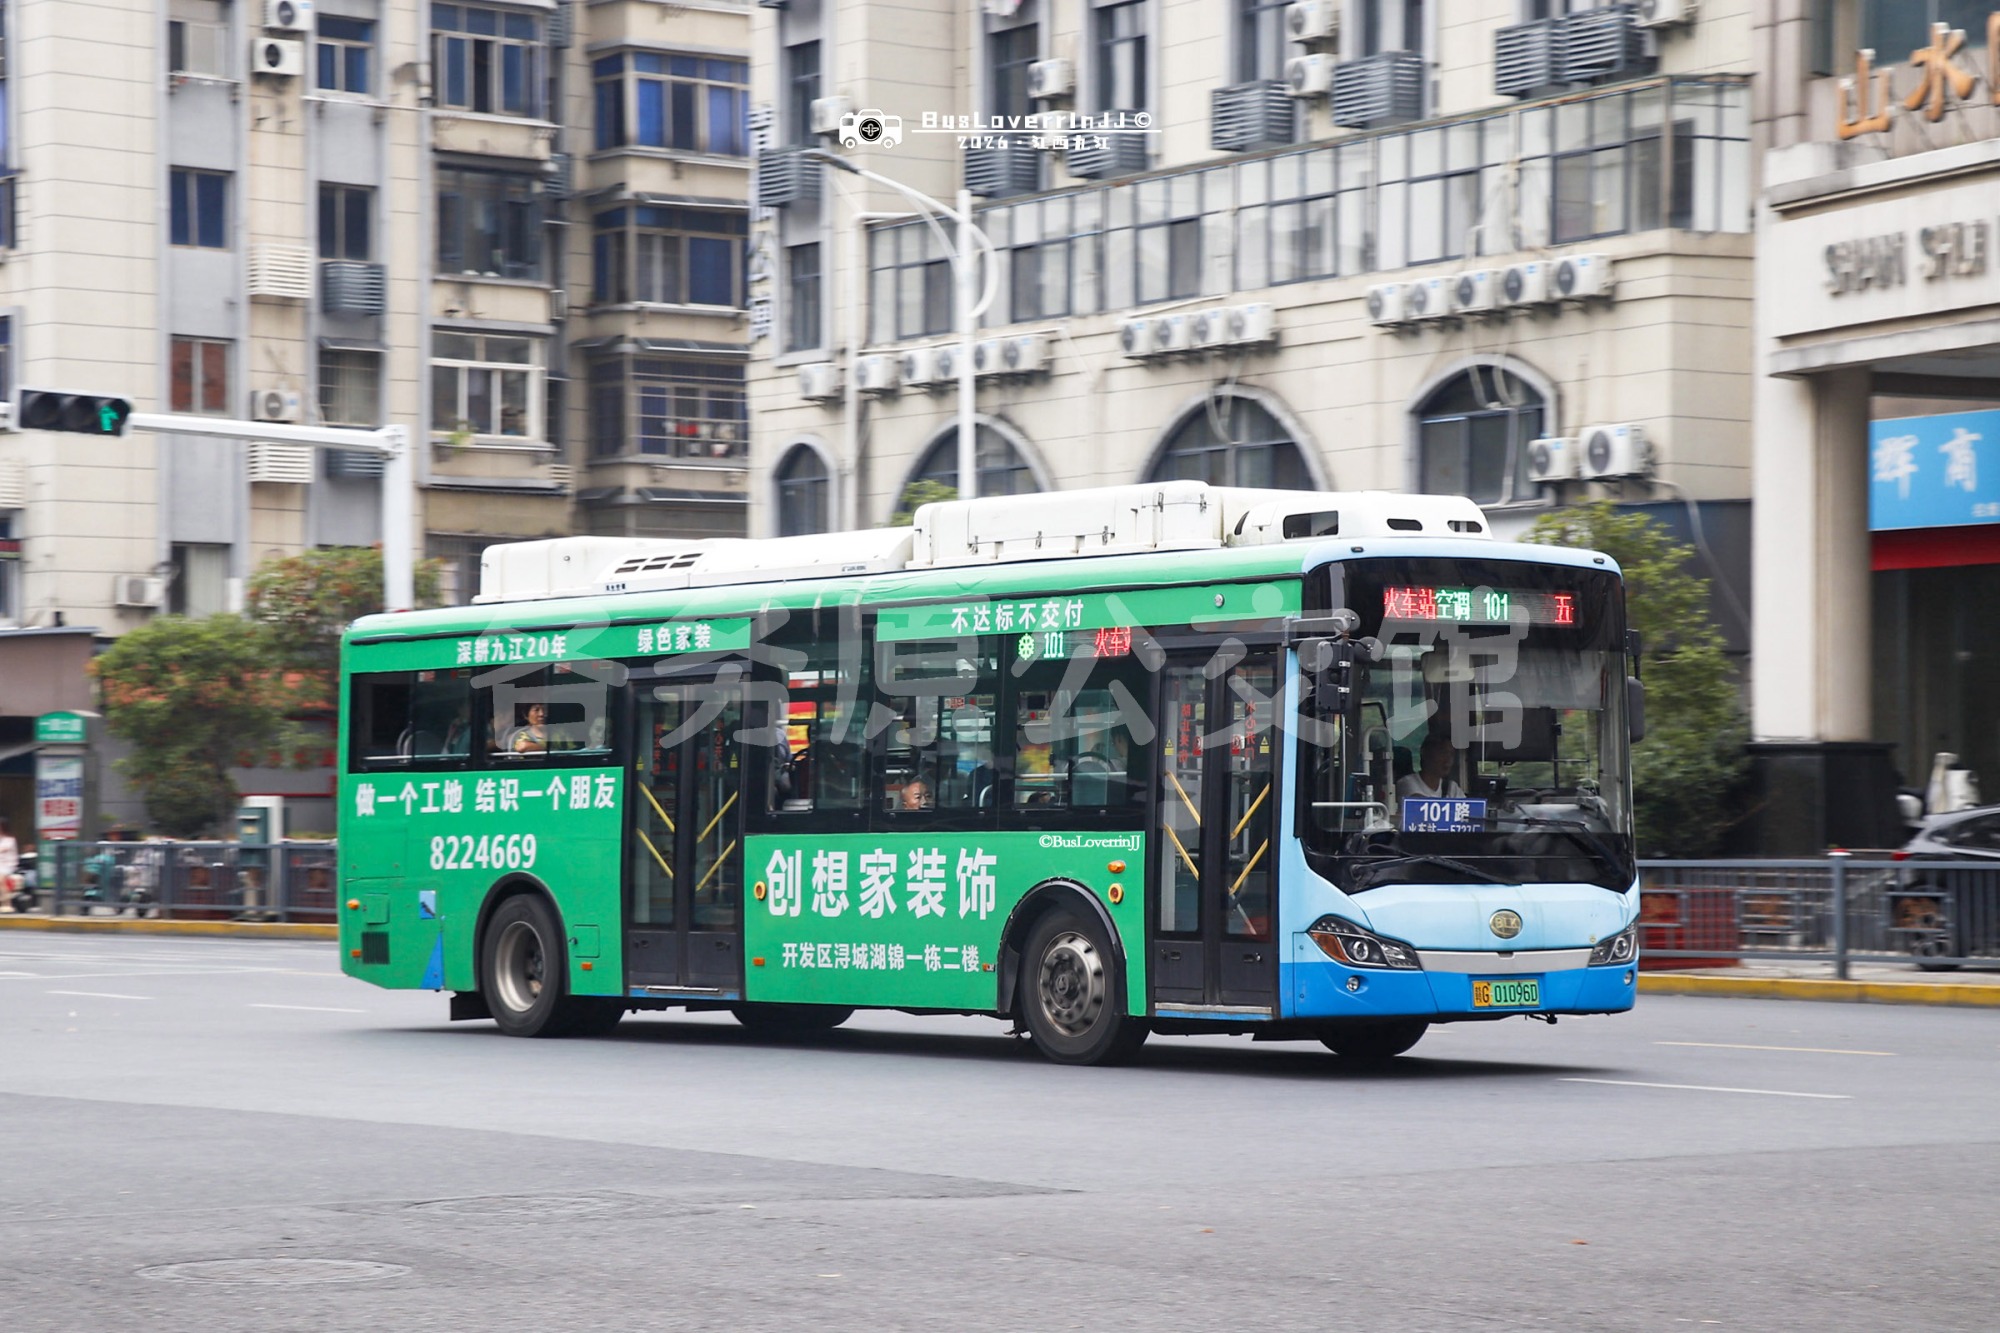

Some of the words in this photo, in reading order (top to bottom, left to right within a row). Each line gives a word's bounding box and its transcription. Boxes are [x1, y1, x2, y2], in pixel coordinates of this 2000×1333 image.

[1838, 11, 2000, 140] 山水
[951, 599, 1084, 634] 不达标不交付
[1483, 592, 1509, 621] 101
[457, 634, 567, 664] 深耕九江20年
[637, 624, 711, 653] 绿色家装
[1043, 632, 1065, 658] 101
[355, 779, 463, 817] 做一个工地
[475, 774, 617, 812] 结识一个朋友
[1420, 802, 1470, 822] 101路
[430, 834, 537, 870] 8224669
[765, 847, 997, 920] 创想家装饰
[782, 942, 980, 973] 开发区浔城湖锦一栋二楼
